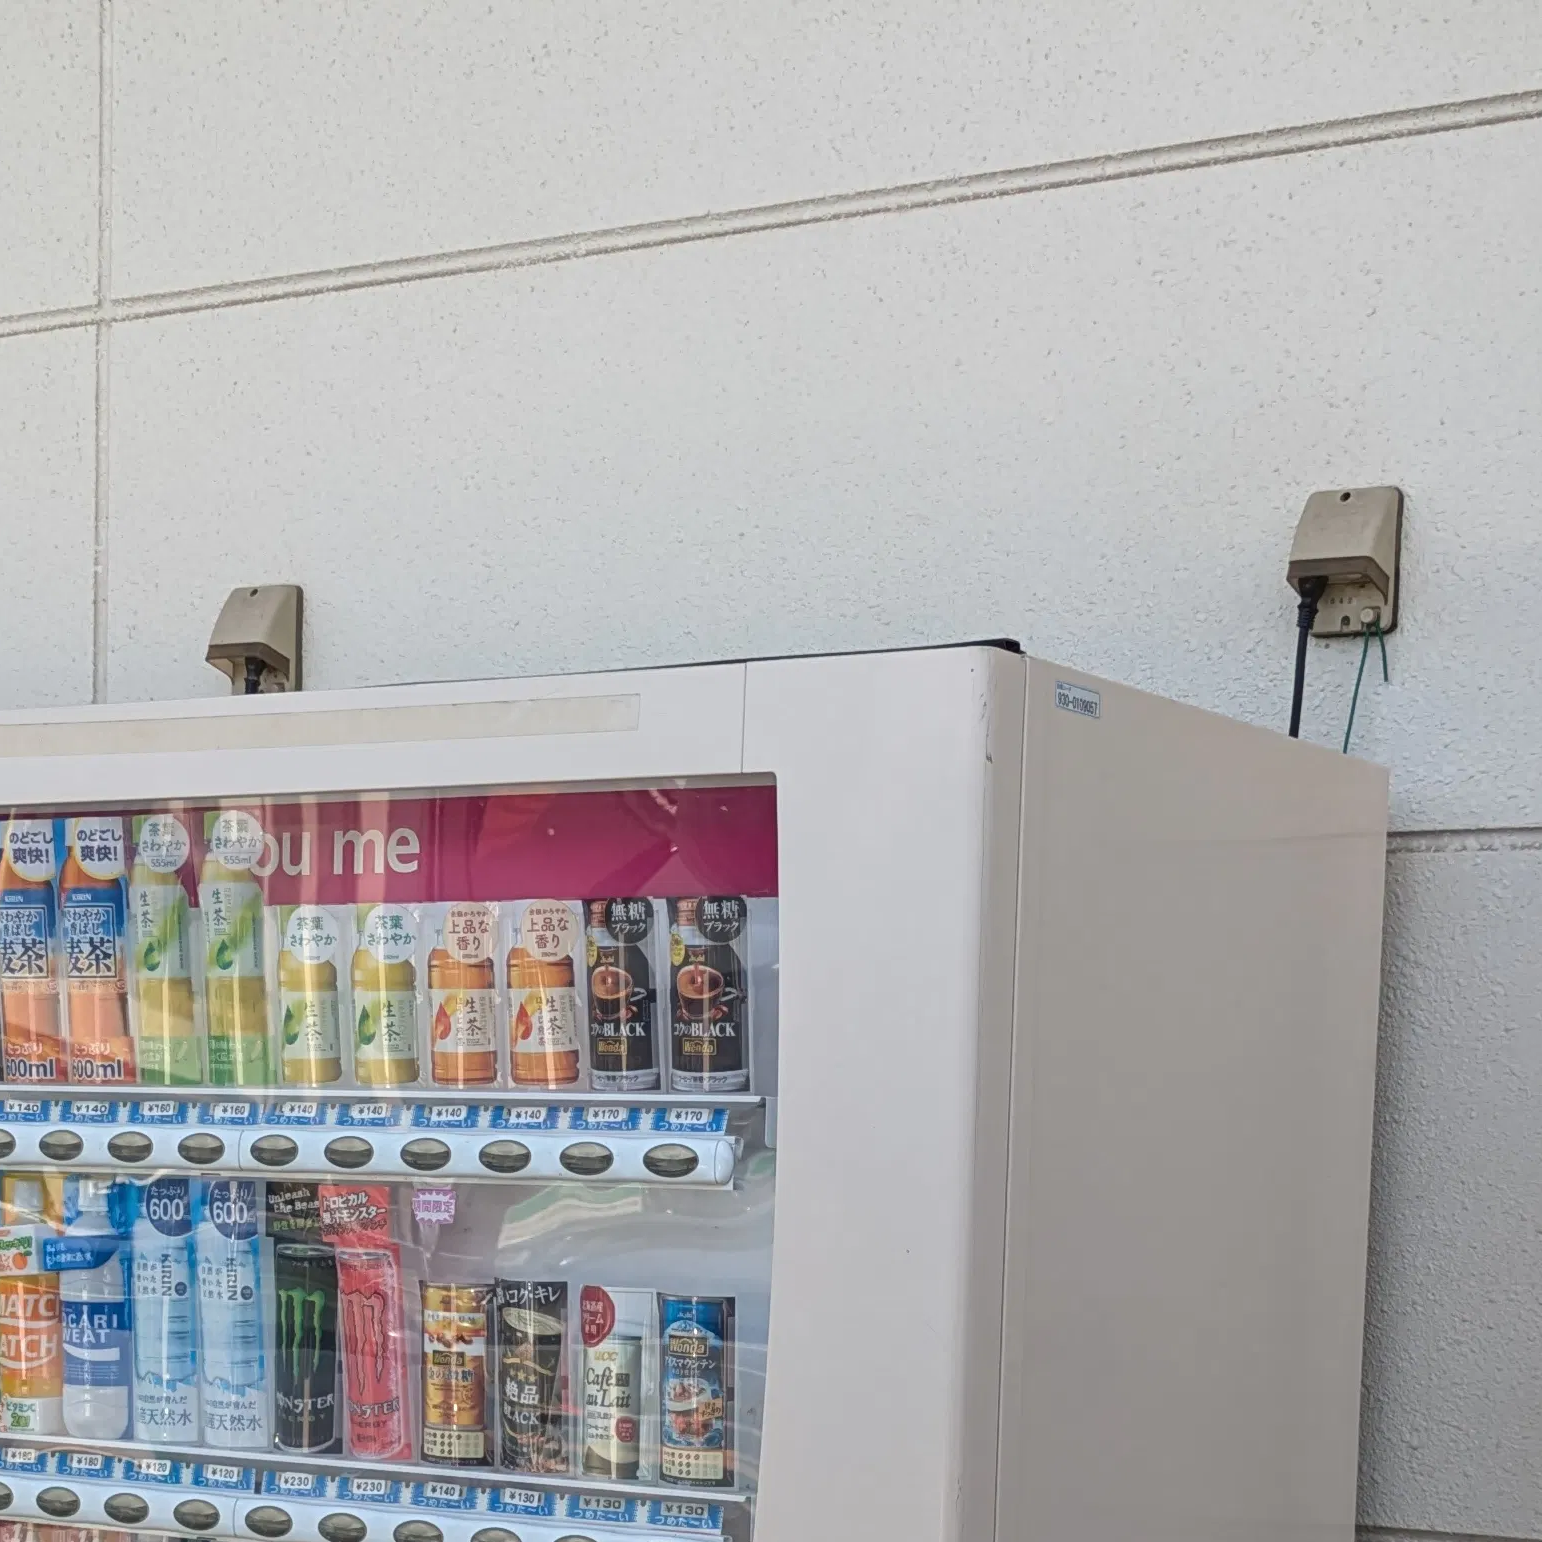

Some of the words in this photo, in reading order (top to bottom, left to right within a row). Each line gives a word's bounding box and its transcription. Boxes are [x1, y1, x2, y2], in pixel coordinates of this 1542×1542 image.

[9, 832, 53, 845] のどごし
[76, 829, 122, 844] のどごし
[141, 838, 187, 851] さわやか
[214, 836, 261, 849] さわやか
[333, 827, 420, 876] me
[139, 892, 153, 929] 生茶
[211, 889, 228, 927] 生茶
[610, 901, 646, 921] 無糖
[702, 899, 739, 920] 無糖
[448, 918, 490, 935] 上品な
[527, 916, 569, 932] 上品な
[611, 921, 646, 934] ブラック
[703, 921, 738, 933] ブラック
[290, 933, 337, 946] さわやか
[366, 933, 416, 945] さわやか
[456, 935, 482, 951] 香り
[535, 933, 561, 949] 香り
[304, 1002, 322, 1042] 生茶
[382, 1000, 401, 1042] 生茶
[464, 996, 480, 1037] 生茶
[546, 995, 562, 1036] 生茶
[161, 1254, 172, 1297] KIRIN
[227, 1257, 239, 1301] KIRIN
[670, 1336, 707, 1355] Wonda
